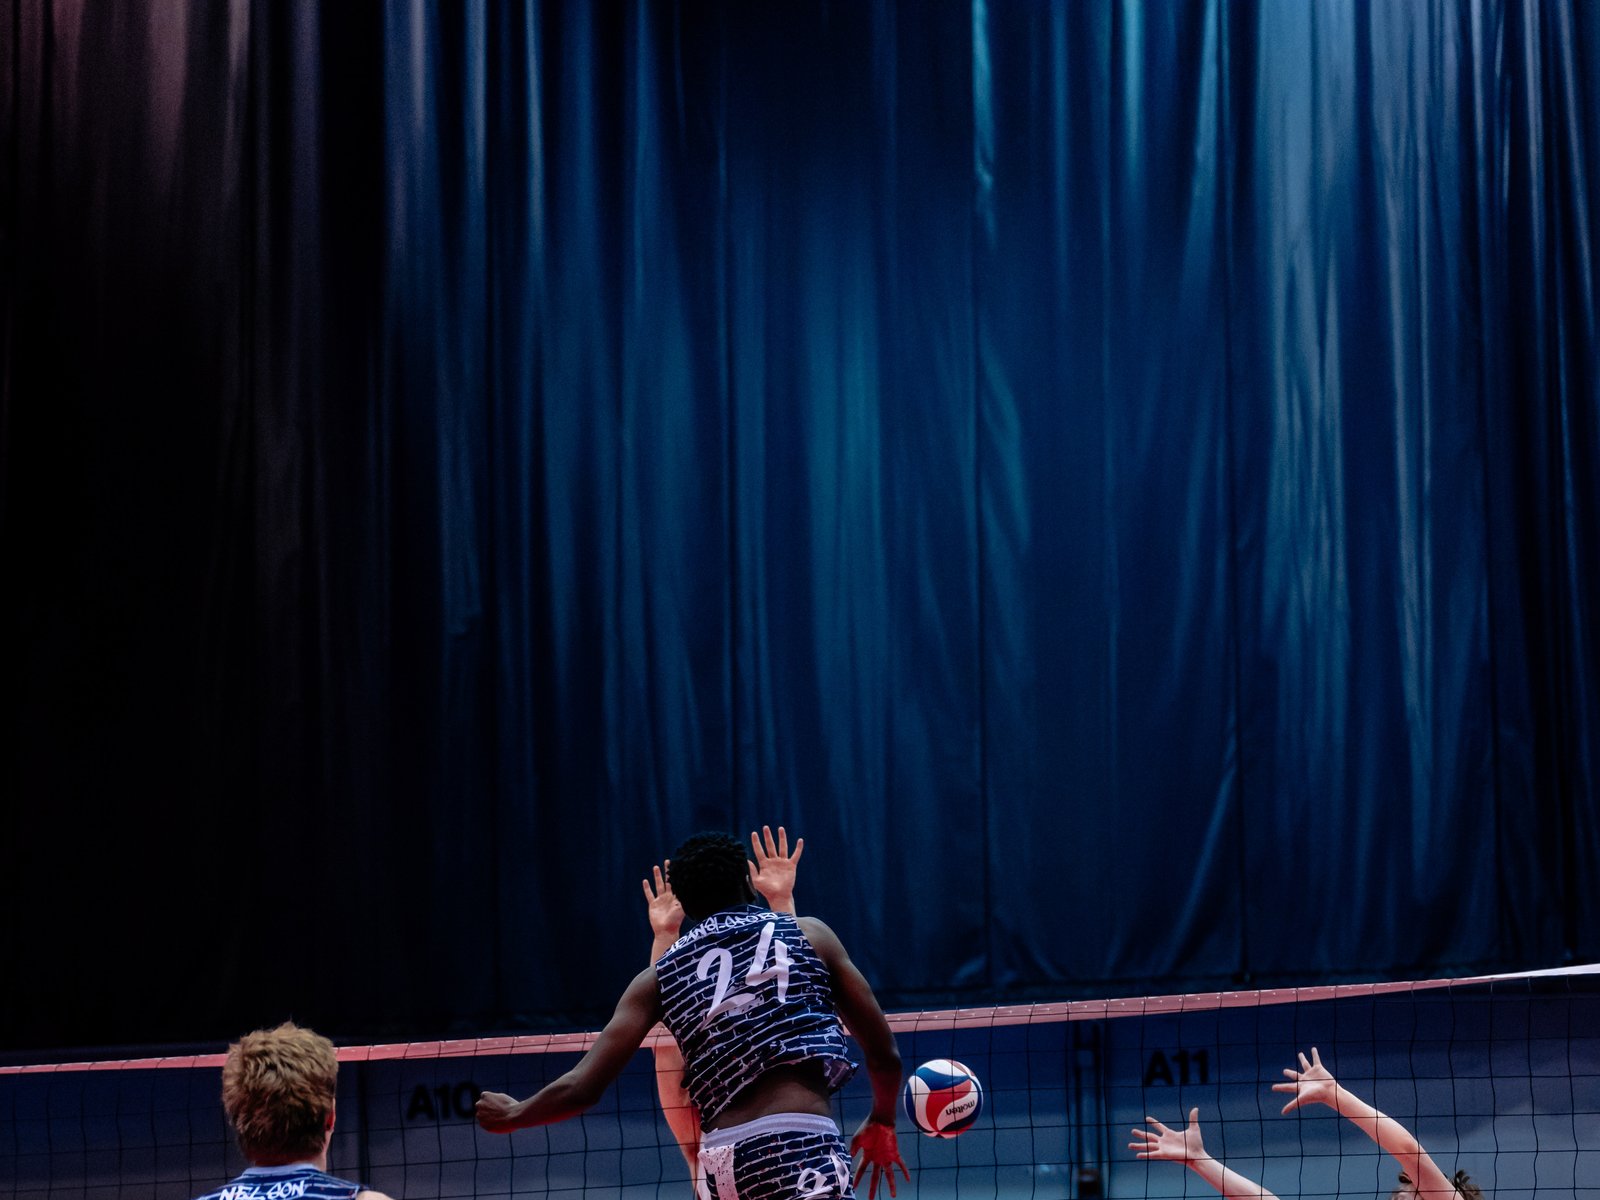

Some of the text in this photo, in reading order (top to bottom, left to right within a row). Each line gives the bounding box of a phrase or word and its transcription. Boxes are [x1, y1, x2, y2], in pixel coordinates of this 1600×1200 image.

[694, 921, 795, 1033] 24
[1145, 1049, 1209, 1086] A11
[407, 1082, 480, 1119] A10
[945, 1100, 976, 1116] molten
